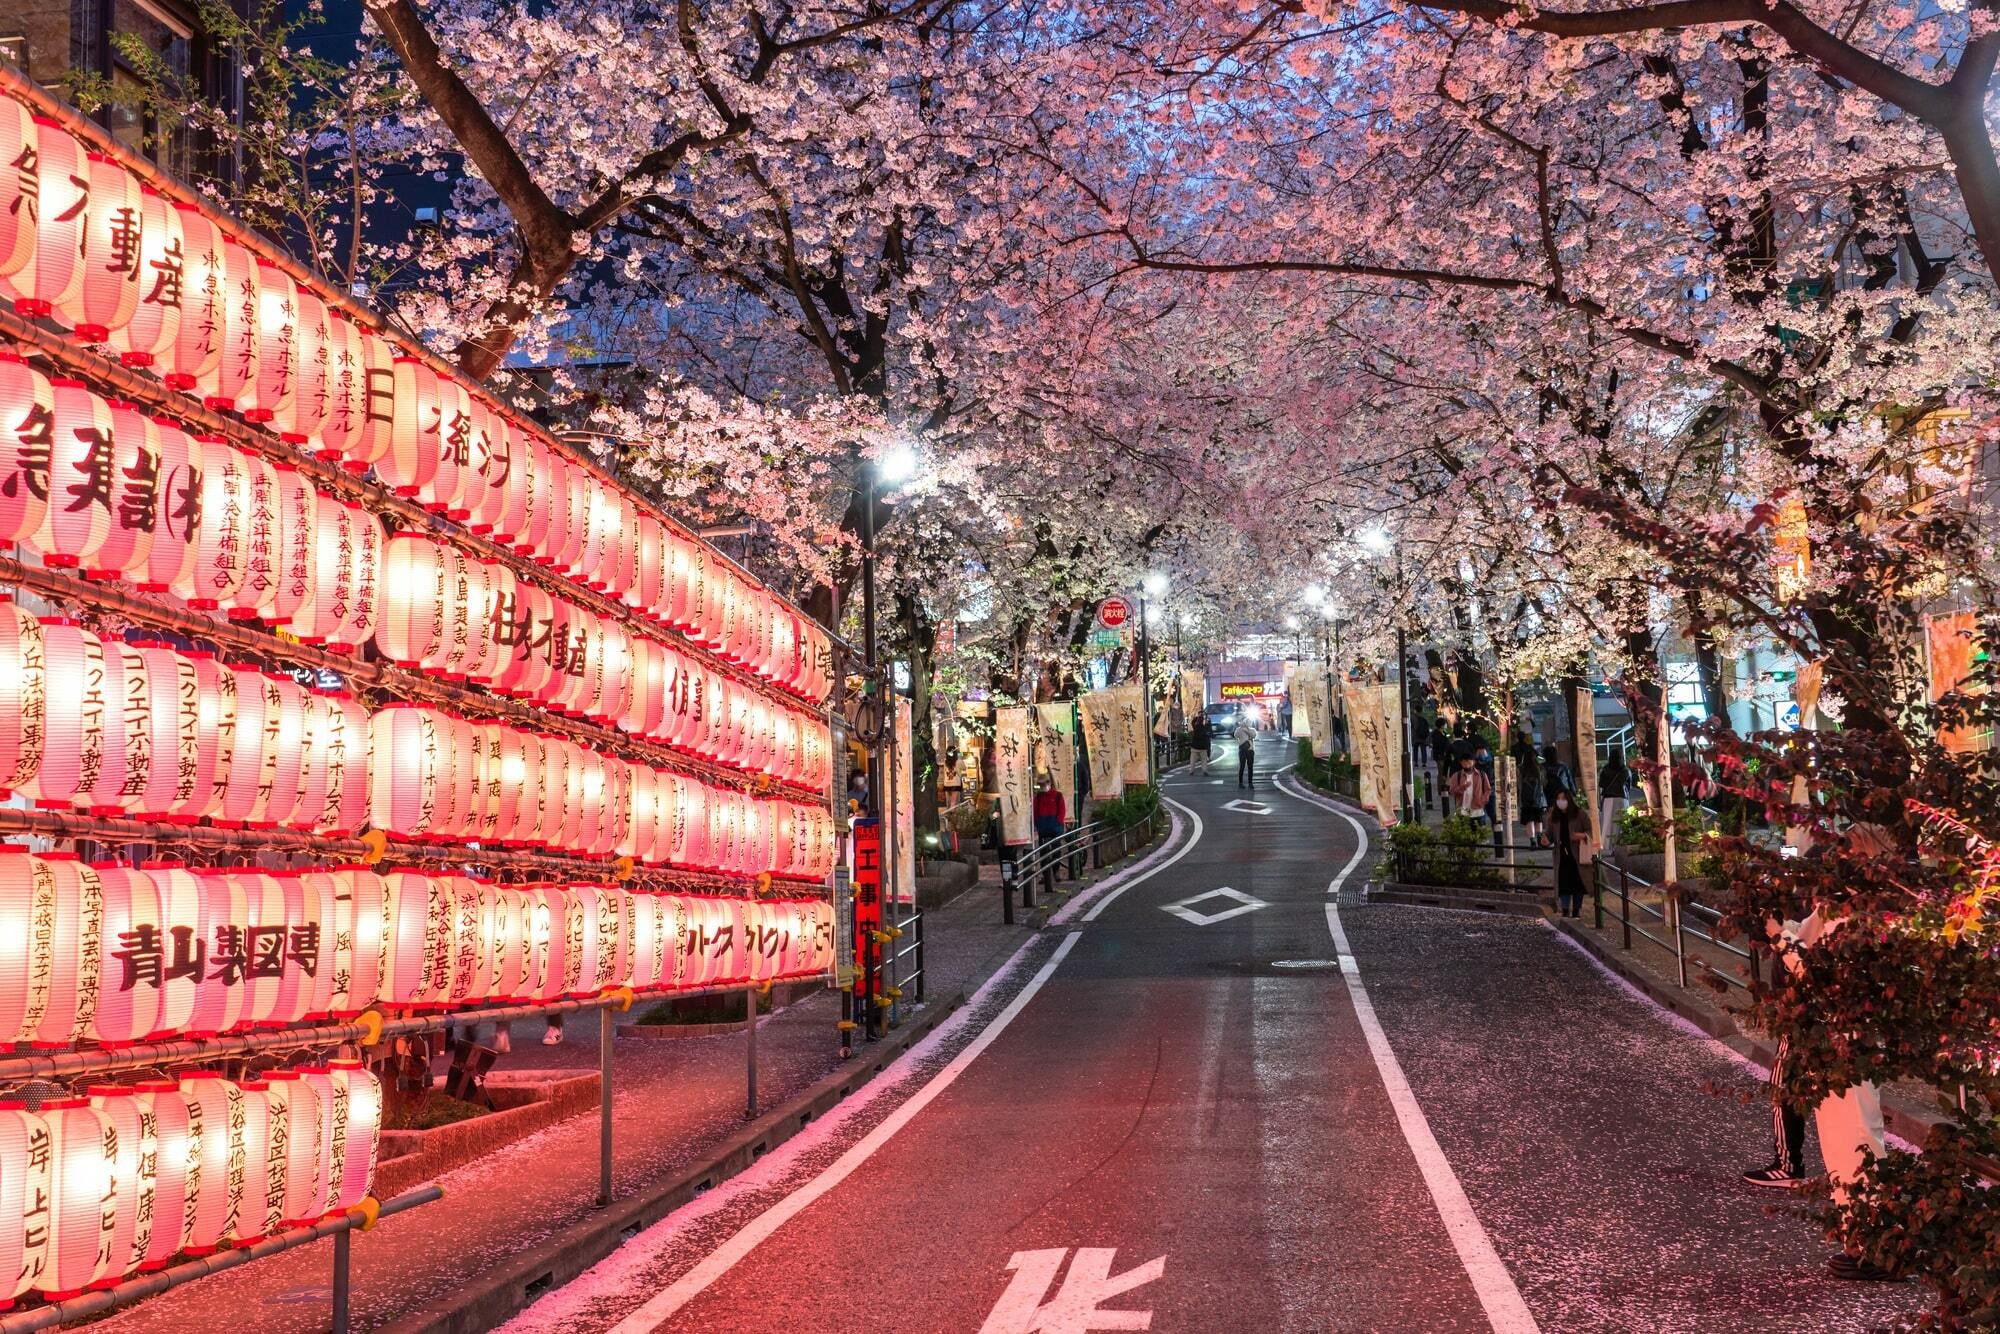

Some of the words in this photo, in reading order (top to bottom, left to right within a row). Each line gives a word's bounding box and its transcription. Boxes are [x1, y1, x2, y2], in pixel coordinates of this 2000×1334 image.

[195, 247, 220, 355] 東急ホテル
[238, 278, 257, 380] 東急ホテル
[272, 299, 295, 396] 東急ホテル
[311, 321, 331, 417] 東急ホテル
[333, 348, 357, 433] 東急ホテル
[213, 463, 241, 589] 再開発準備組合
[250, 473, 275, 591] 再開発準備組合
[288, 488, 312, 597] 再開発準備組合
[333, 510, 353, 619] 再開発準備組合
[352, 525, 377, 629] 再開発準備組合
[4, 614, 44, 788] 桜丘法律事務所
[75, 642, 104, 794] コクエイ不動産
[119, 655, 151, 797] コクエイ不動産
[173, 662, 200, 801] コクエイ不動産
[332, 893, 353, 995] 一風堂
[259, 1103, 288, 1232] 渋谷区桜丘町会
